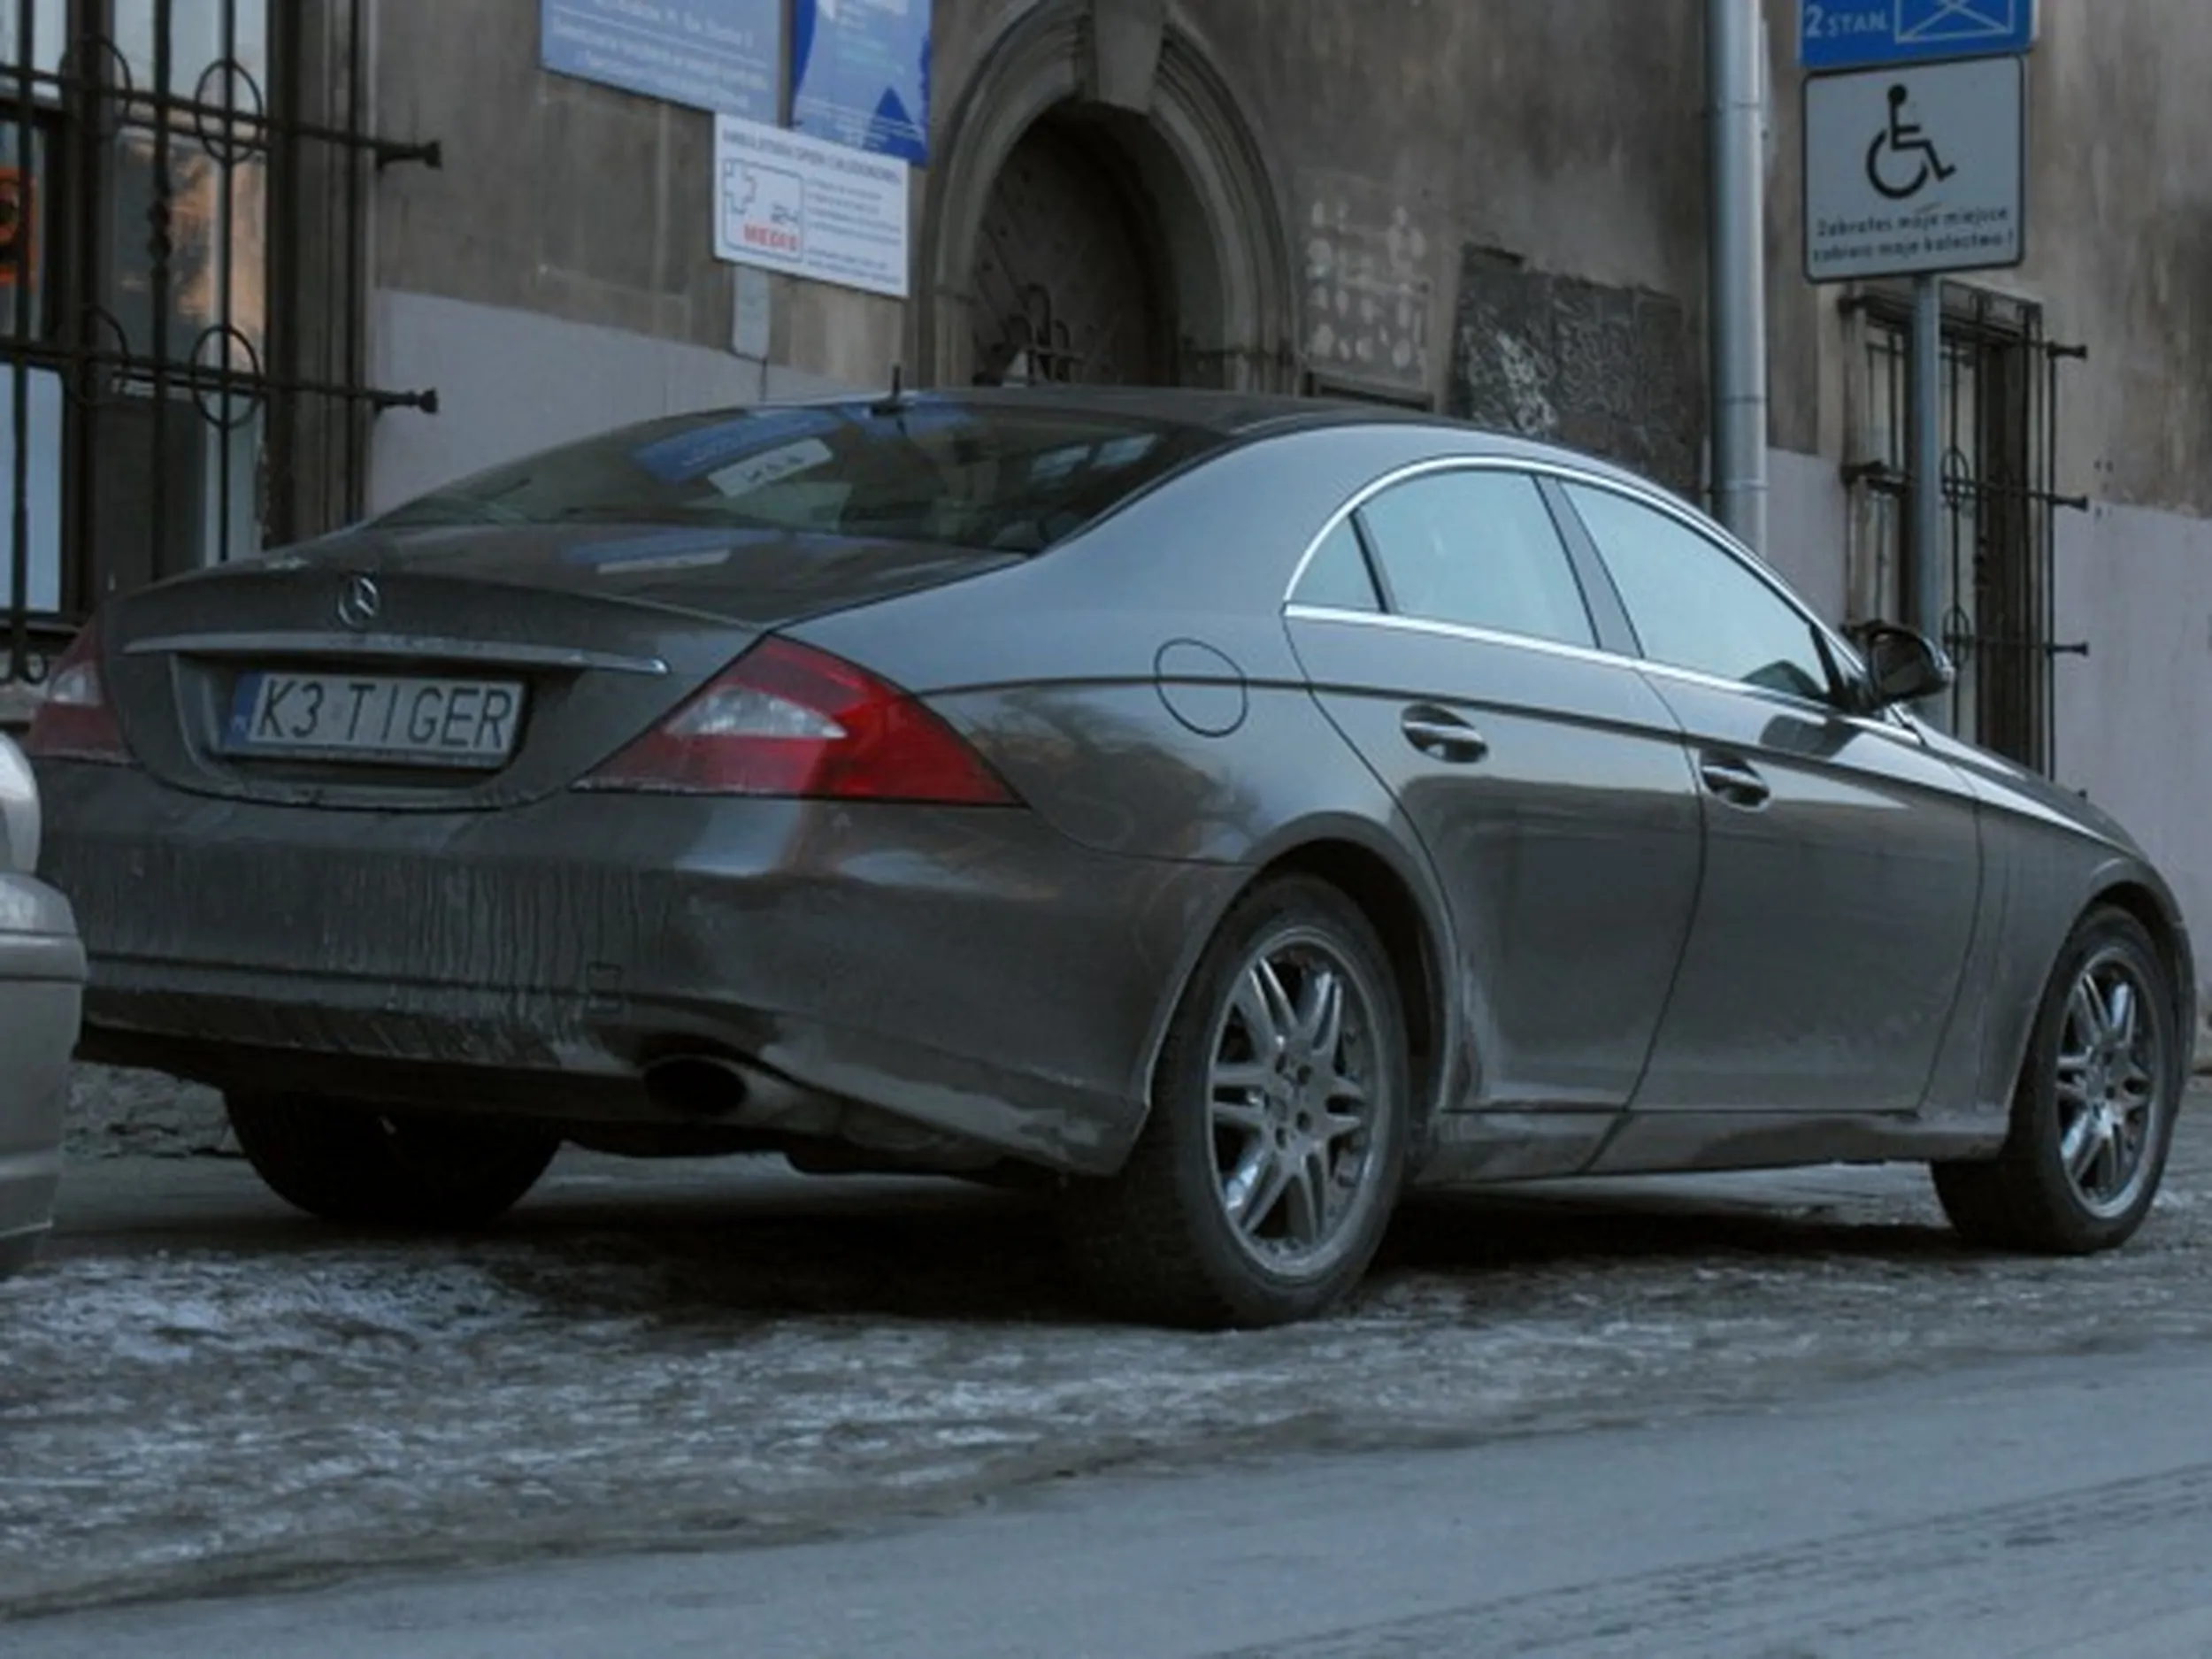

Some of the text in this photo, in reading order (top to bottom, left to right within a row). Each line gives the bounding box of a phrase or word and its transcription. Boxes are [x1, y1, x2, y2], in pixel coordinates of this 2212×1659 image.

[1805, 4, 1824, 38] 2
[257, 679, 512, 749] K3 TIGER
